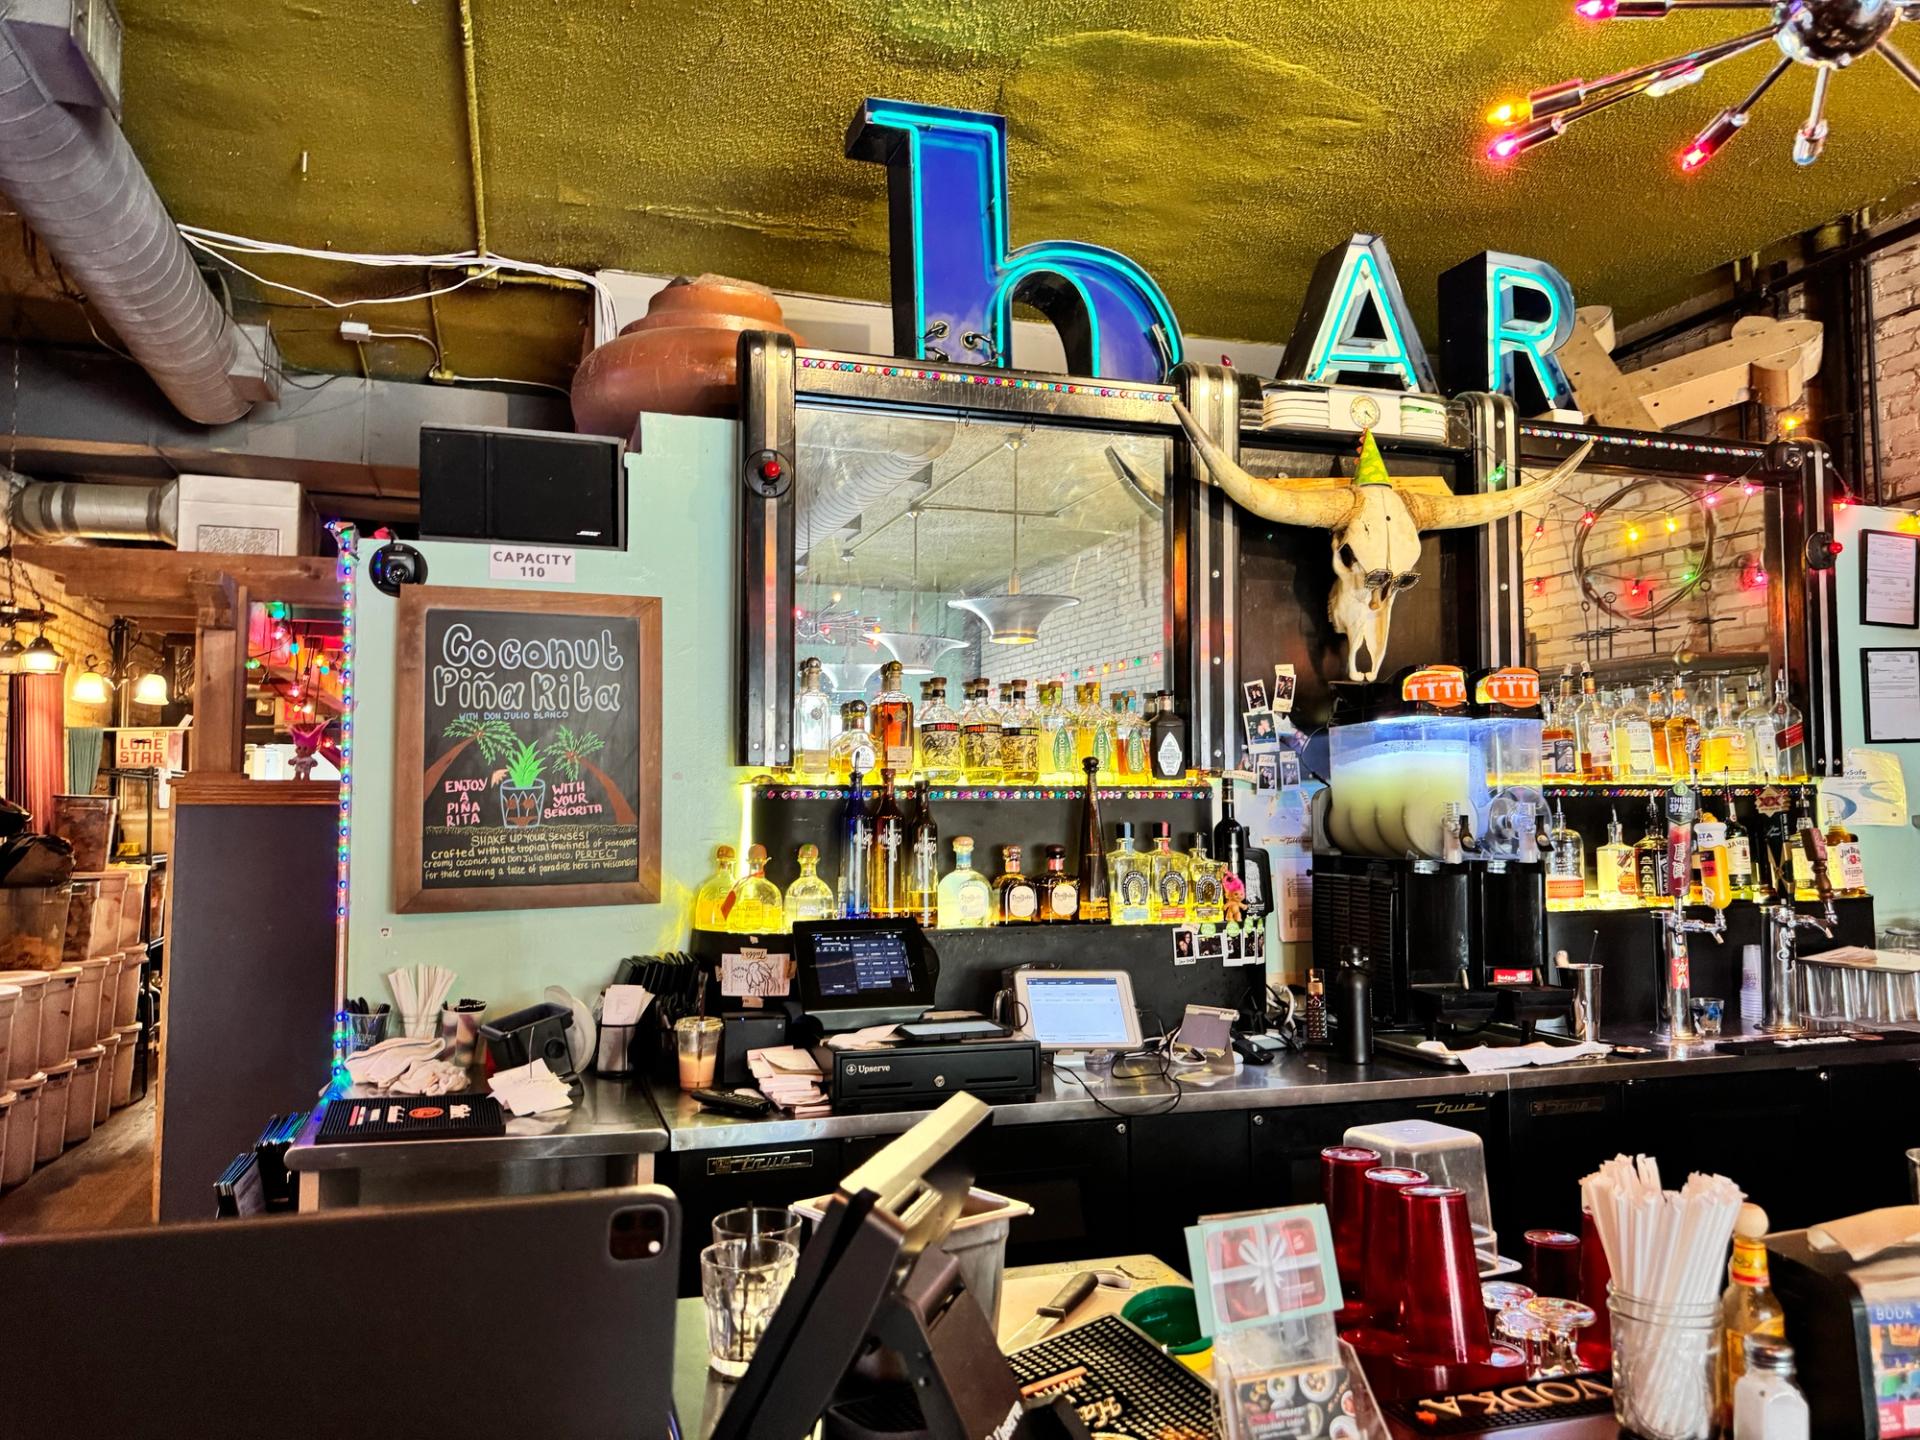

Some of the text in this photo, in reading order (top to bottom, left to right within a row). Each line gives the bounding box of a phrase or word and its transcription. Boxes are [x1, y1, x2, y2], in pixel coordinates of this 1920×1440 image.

[493, 551, 572, 566] CAPACITY
[520, 566, 546, 578] 110
[442, 623, 624, 672] Coconut
[433, 665, 621, 713] Piña Rita
[459, 710, 569, 721] WITH DON JULIO BLANCO
[120, 738, 163, 750] LONE
[120, 751, 163, 764] STAR
[445, 777, 488, 793] ENJOY
[552, 780, 585, 795] WITH
[460, 791, 469, 803] A
[553, 792, 588, 808] YOUR
[447, 800, 480, 815] PIÑA
[544, 804, 602, 819] SEÑORITA
[446, 813, 480, 827] RITA
[470, 834, 507, 847] SHAKE
[509, 832, 523, 843] UP
[523, 831, 547, 843] YOUR
[431, 847, 475, 860] crafted
[478, 845, 499, 855] with
[501, 844, 516, 854] the
[516, 842, 550, 854] tropical
[592, 838, 602, 848] of
[423, 860, 454, 870] creamy
[490, 855, 506, 865] and
[575, 848, 619, 862] PERFECT
[463, 867, 496, 880] craving
[498, 867, 505, 875] a
[528, 863, 537, 874] of
[539, 861, 571, 876] paradise
[572, 860, 588, 870] here
[591, 860, 601, 869] in
[858, 1064, 891, 1075] Upserve
[1424, 1101, 1481, 1114] true
[1418, 1378, 1614, 1418] VODKA
